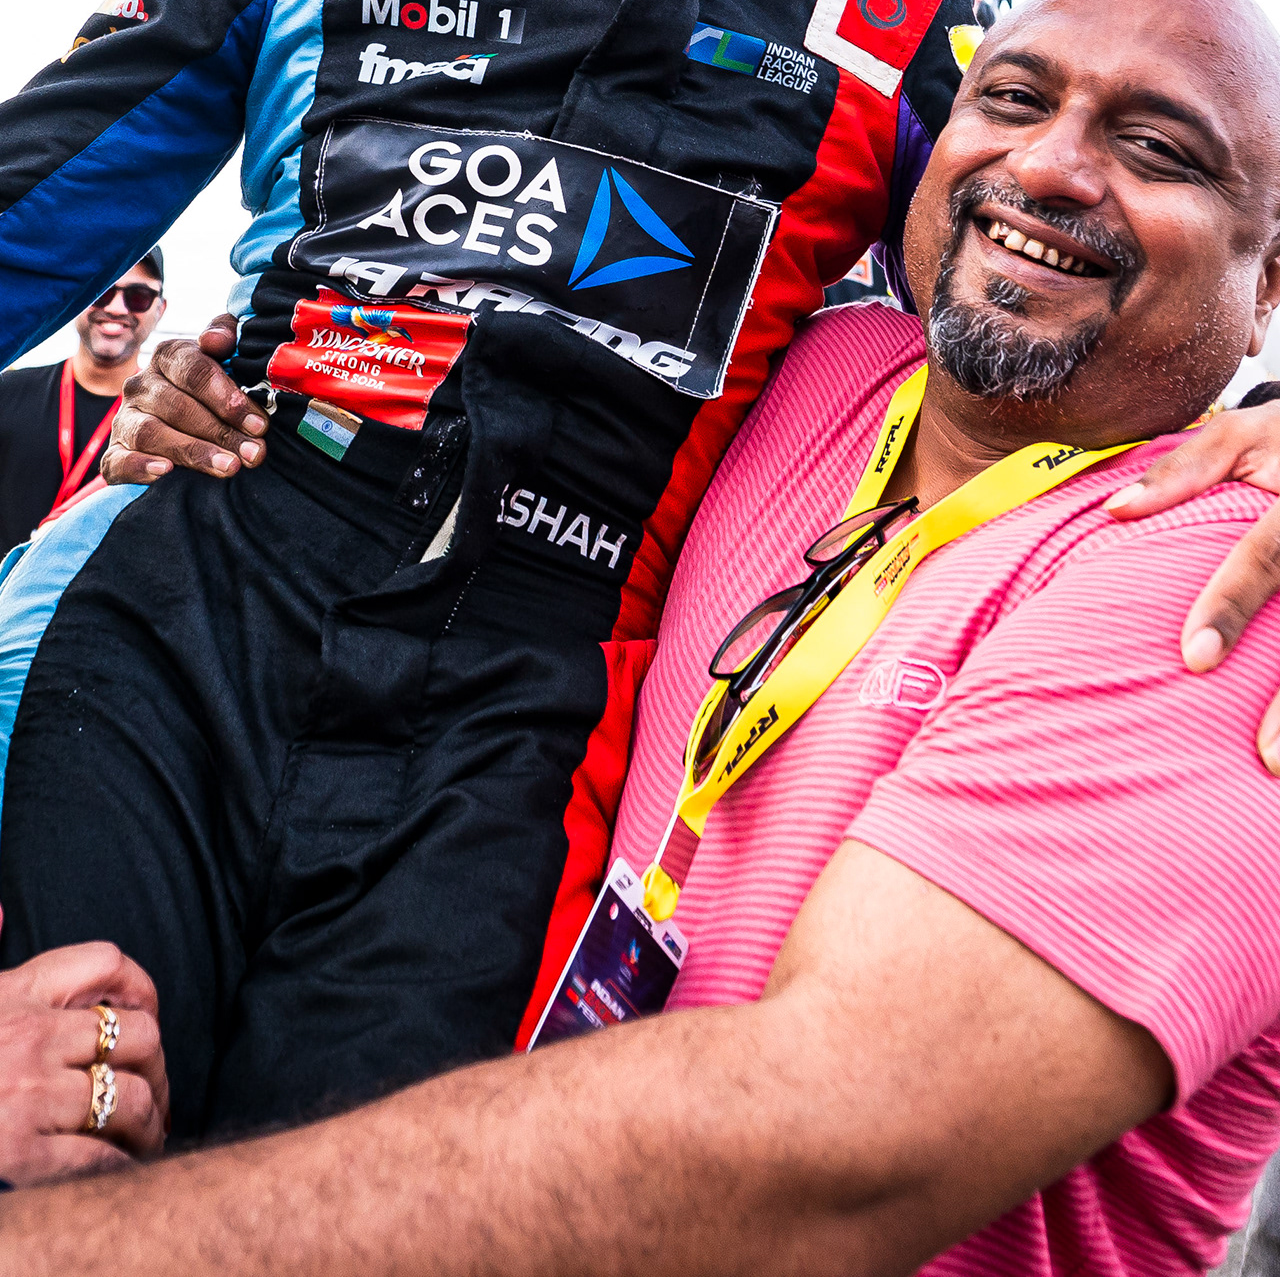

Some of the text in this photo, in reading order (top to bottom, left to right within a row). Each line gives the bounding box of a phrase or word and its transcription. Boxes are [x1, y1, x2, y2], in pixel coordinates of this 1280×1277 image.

[498, 8, 513, 41] 1
[762, 55, 818, 83] RACING
[765, 41, 816, 68] INDIAN
[757, 70, 814, 95] LEAGUE
[407, 140, 568, 214] GOA
[356, 188, 559, 267] ACES
[304, 359, 386, 391] POWER SODA
[320, 350, 382, 377] STRONG
[874, 415, 905, 474] RPPL
[717, 703, 780, 784] RPPL
